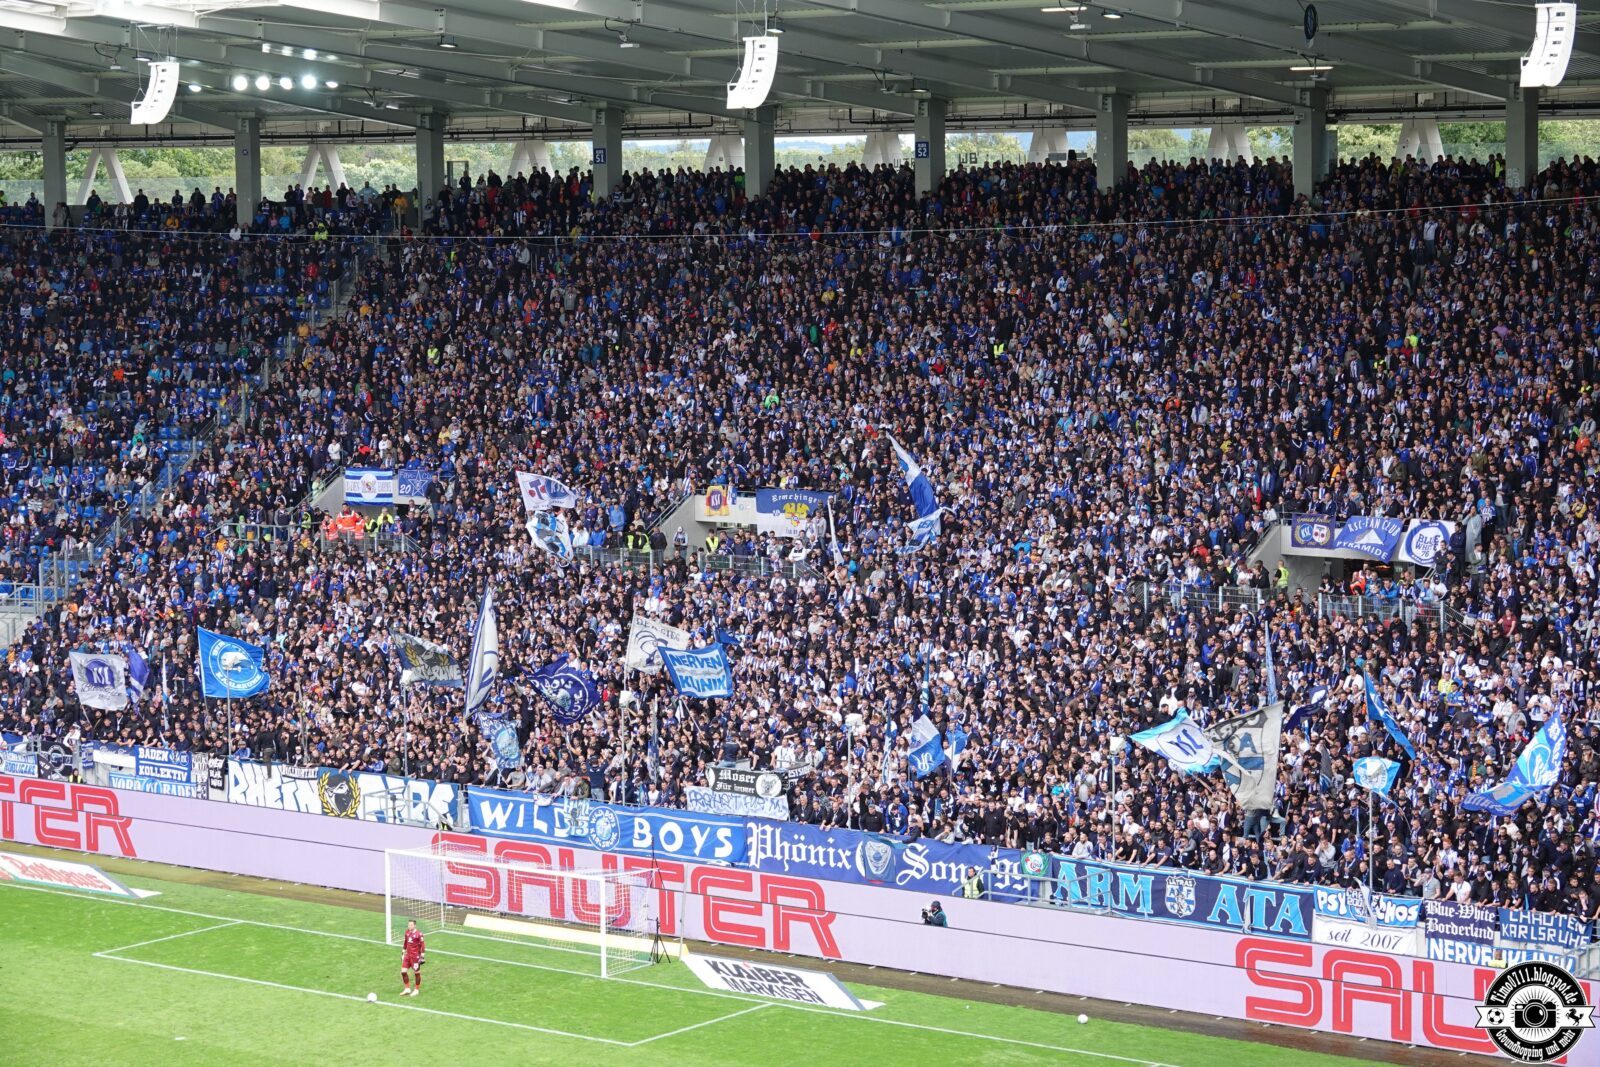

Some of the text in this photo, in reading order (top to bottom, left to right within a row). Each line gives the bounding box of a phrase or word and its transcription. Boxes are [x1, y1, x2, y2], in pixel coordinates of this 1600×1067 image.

[595, 154, 604, 163] S1
[917, 148, 927, 157] S2
[710, 494, 721, 507] KSC
[771, 493, 818, 504] Remchinge
[1300, 526, 1311, 539] KSC
[1381, 520, 1401, 537] CLUB
[1418, 533, 1441, 544] BLUE
[1336, 541, 1388, 560] PYRAMIDE
[668, 653, 722, 669] NERVEN
[679, 674, 727, 693] KLINIK
[138, 747, 169, 762] BADEN
[138, 765, 188, 782] KOLLEKTIV
[718, 770, 756, 784] Moser
[228, 759, 323, 814] RHEIN
[715, 781, 756, 794] Für immer
[480, 800, 571, 838] WILD
[632, 817, 733, 858] BOYS
[747, 822, 852, 872] Phönix
[1168, 878, 1193, 887] ULTRAS
[432, 833, 842, 959] SAUTER
[1053, 861, 1309, 935] ARM ATA
[1425, 900, 1496, 922] Blue-White
[1425, 918, 1494, 940] Borderland
[1501, 924, 1590, 949] KARLSRUHE
[1329, 928, 1404, 950] seit 2007
[704, 959, 811, 989] KLAIBER
[721, 976, 828, 1005] MARKISEN
